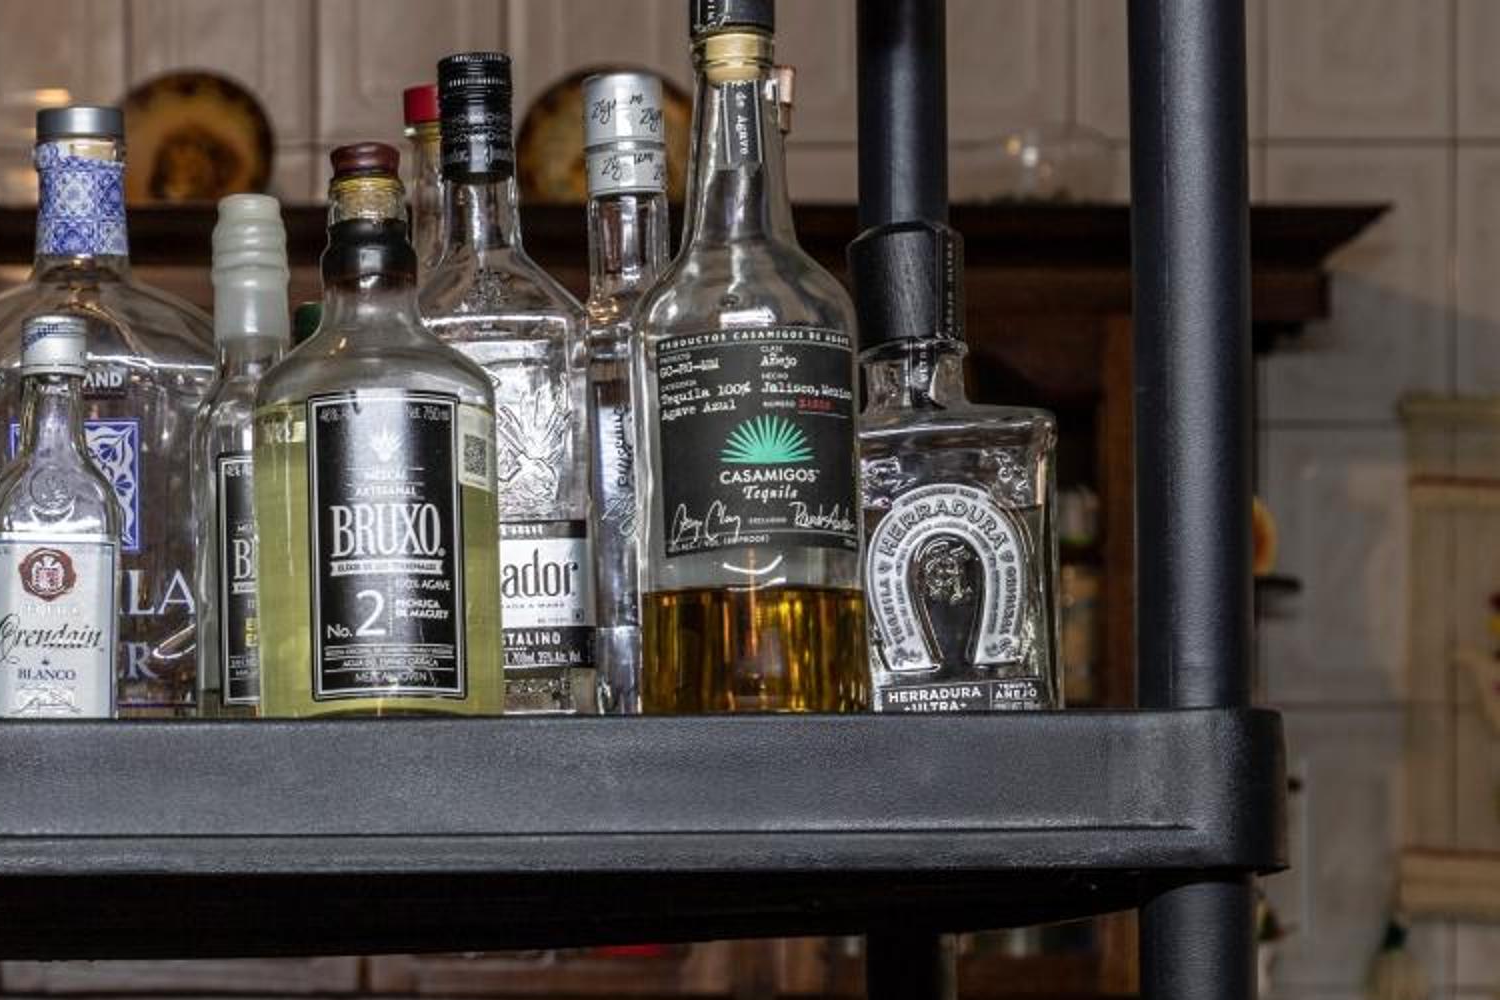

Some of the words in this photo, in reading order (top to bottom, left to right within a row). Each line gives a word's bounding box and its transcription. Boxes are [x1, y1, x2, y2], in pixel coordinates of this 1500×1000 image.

[83, 371, 124, 388] AND
[720, 469, 816, 484] CASAMIGOS
[743, 485, 799, 502] Tequila
[330, 503, 441, 557] BRUXO
[882, 498, 1010, 556] HERRADURA
[502, 548, 579, 599] ador
[356, 590, 386, 636] 2
[502, 631, 561, 646] TALINO
[18, 668, 76, 681] BLANCO
[888, 685, 982, 704] HERRADURA
